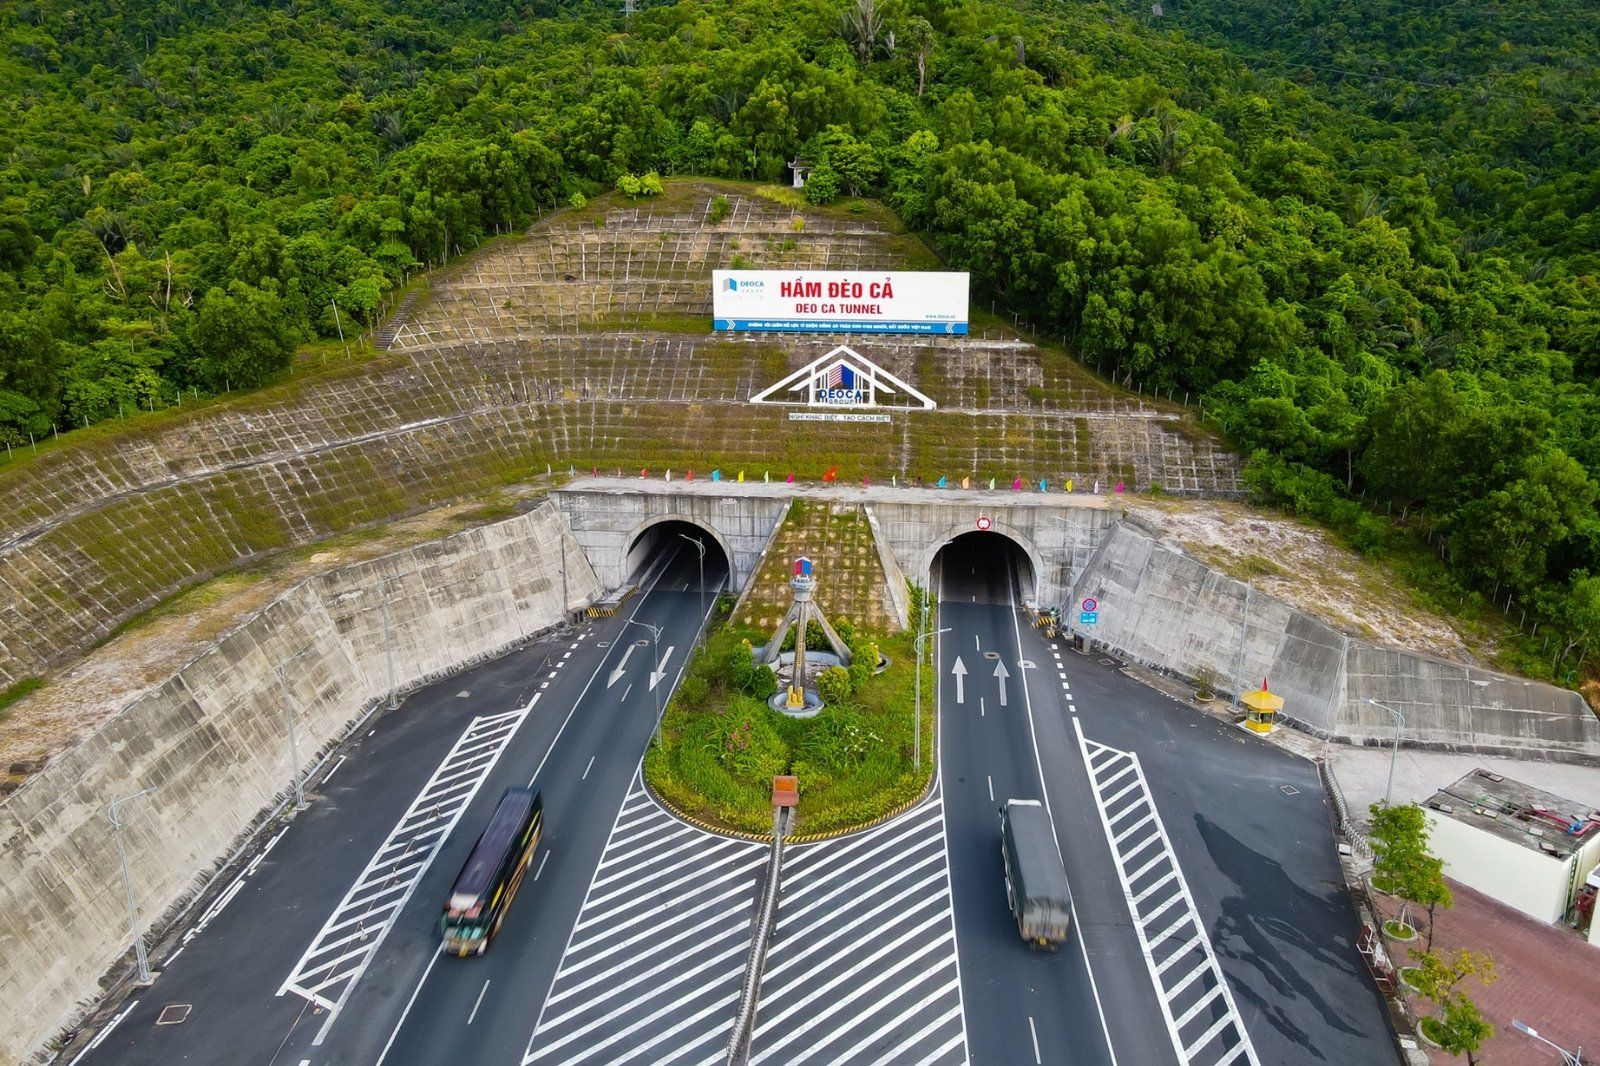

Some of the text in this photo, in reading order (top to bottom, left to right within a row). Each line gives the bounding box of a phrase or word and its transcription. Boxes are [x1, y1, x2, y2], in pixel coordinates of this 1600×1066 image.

[780, 276, 894, 299] HẦM ĐÈO CẢ
[796, 303, 883, 314] DEO CA TUNNEL
[819, 389, 862, 400] DEOCA
